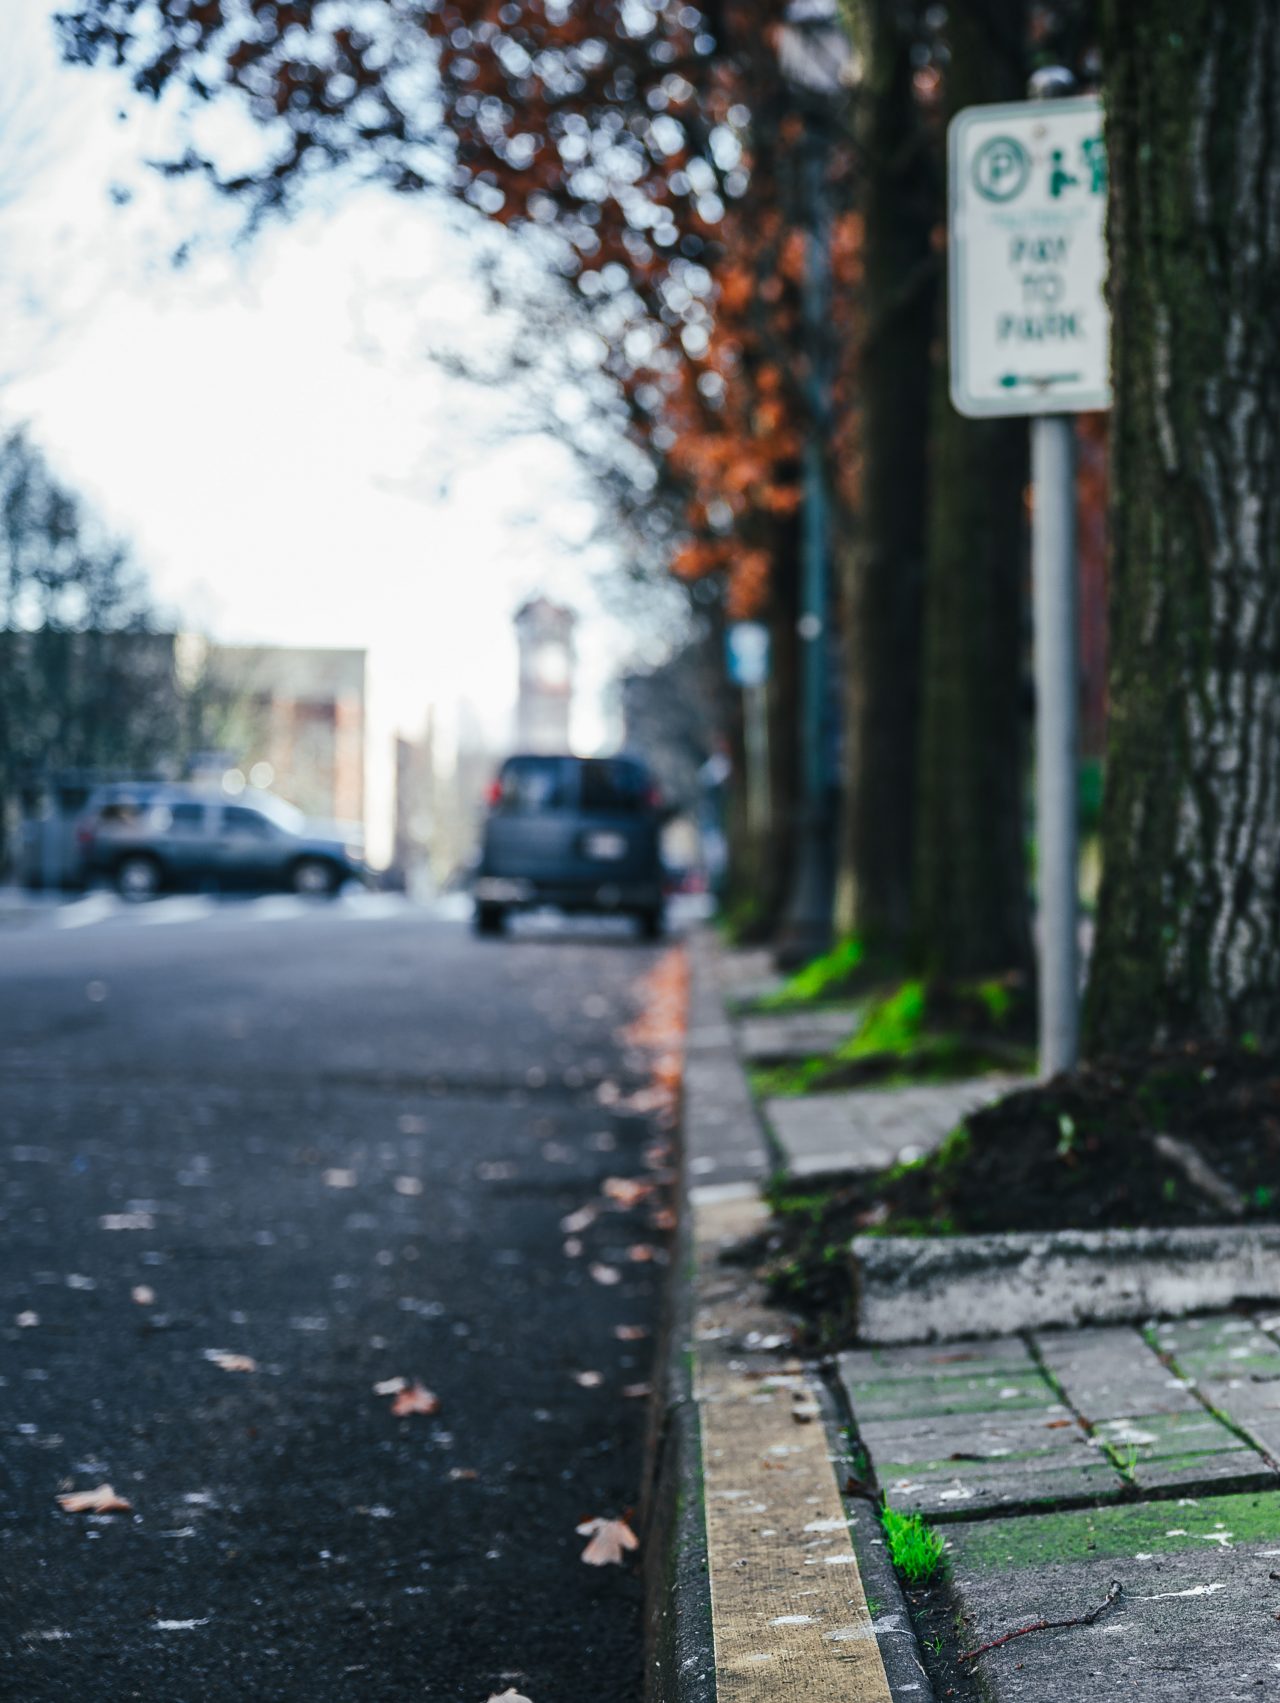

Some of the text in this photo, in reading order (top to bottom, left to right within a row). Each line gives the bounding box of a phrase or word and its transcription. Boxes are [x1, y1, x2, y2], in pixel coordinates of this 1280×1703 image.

[1009, 235, 1068, 264] PAY
[1020, 273, 1066, 304] TO
[995, 310, 1087, 346] PARK
